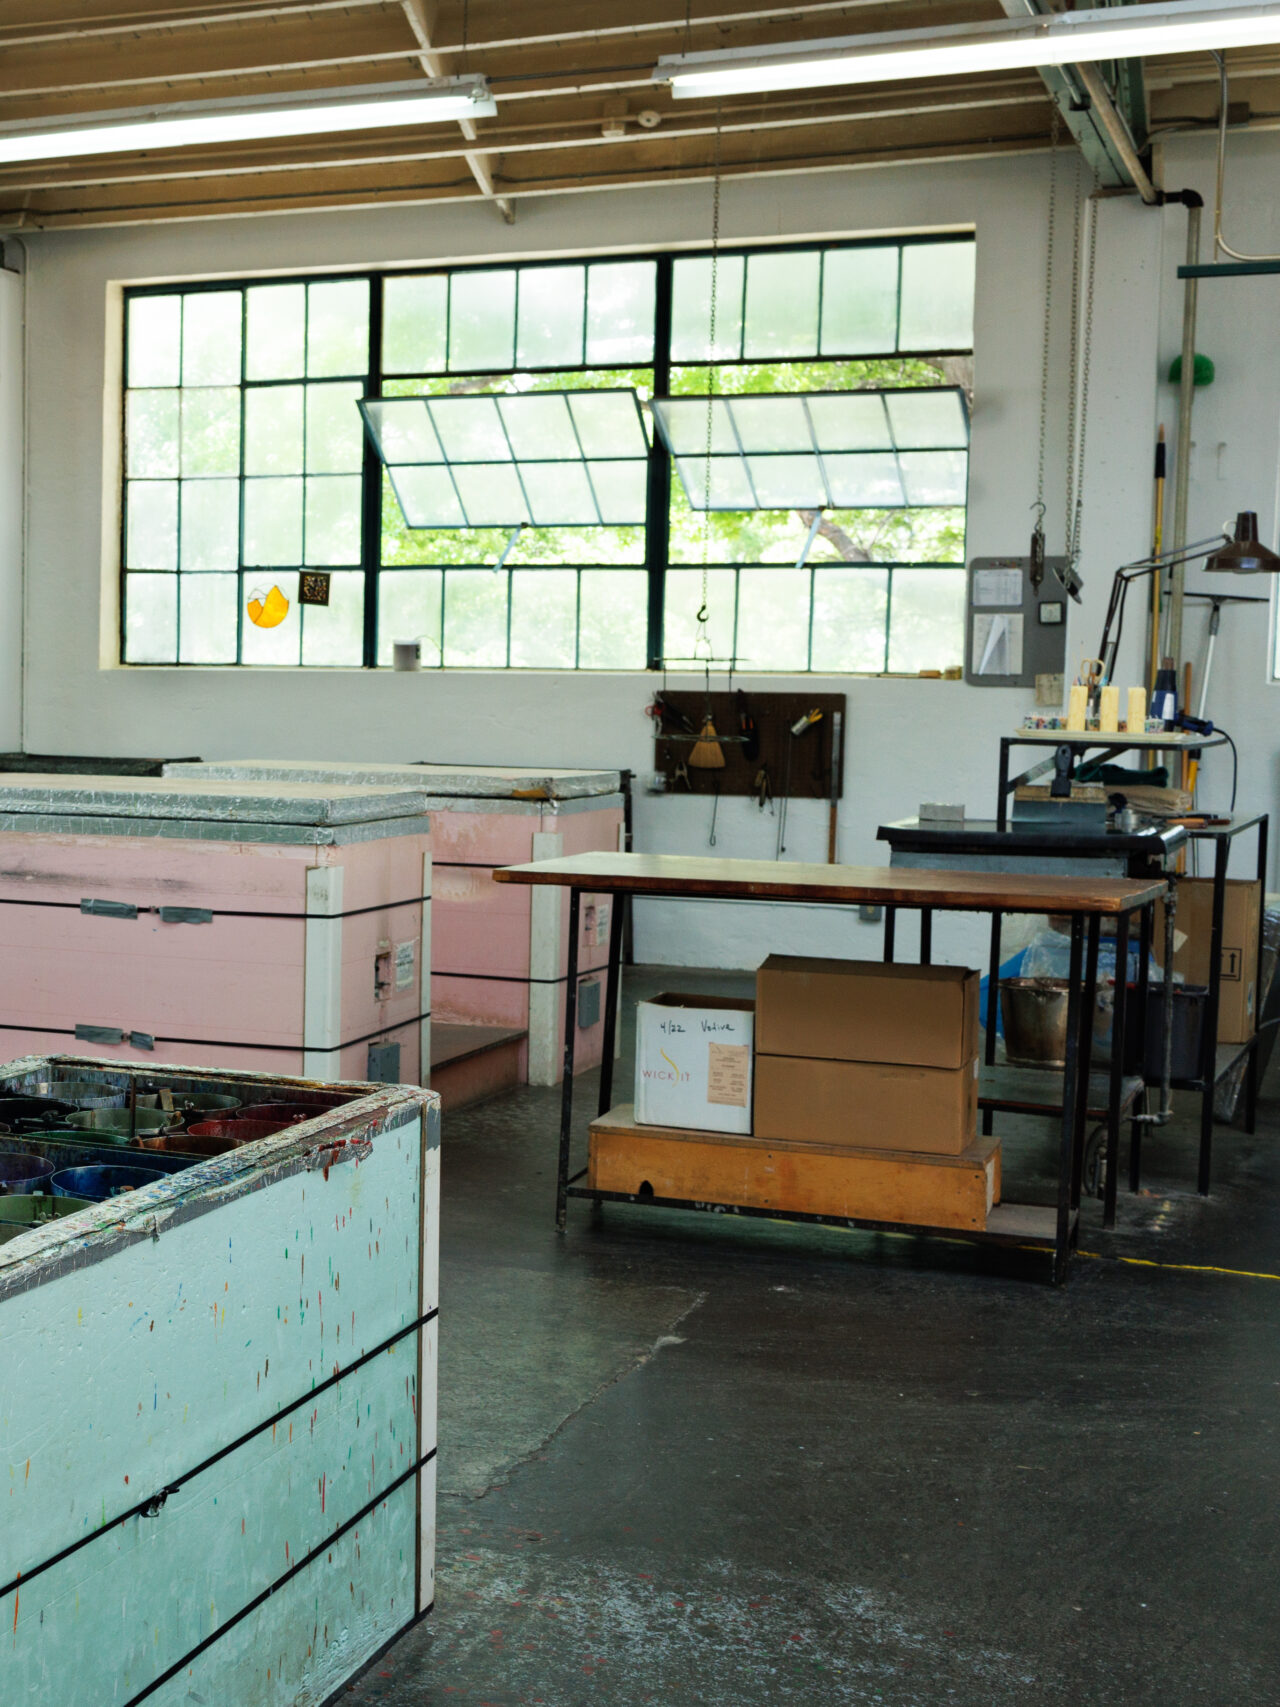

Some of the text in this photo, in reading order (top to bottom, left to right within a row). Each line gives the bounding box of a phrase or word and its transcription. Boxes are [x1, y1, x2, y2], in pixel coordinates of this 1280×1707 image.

[660, 1019, 686, 1035] 4/22
[642, 1070, 690, 1082] WICK IT
